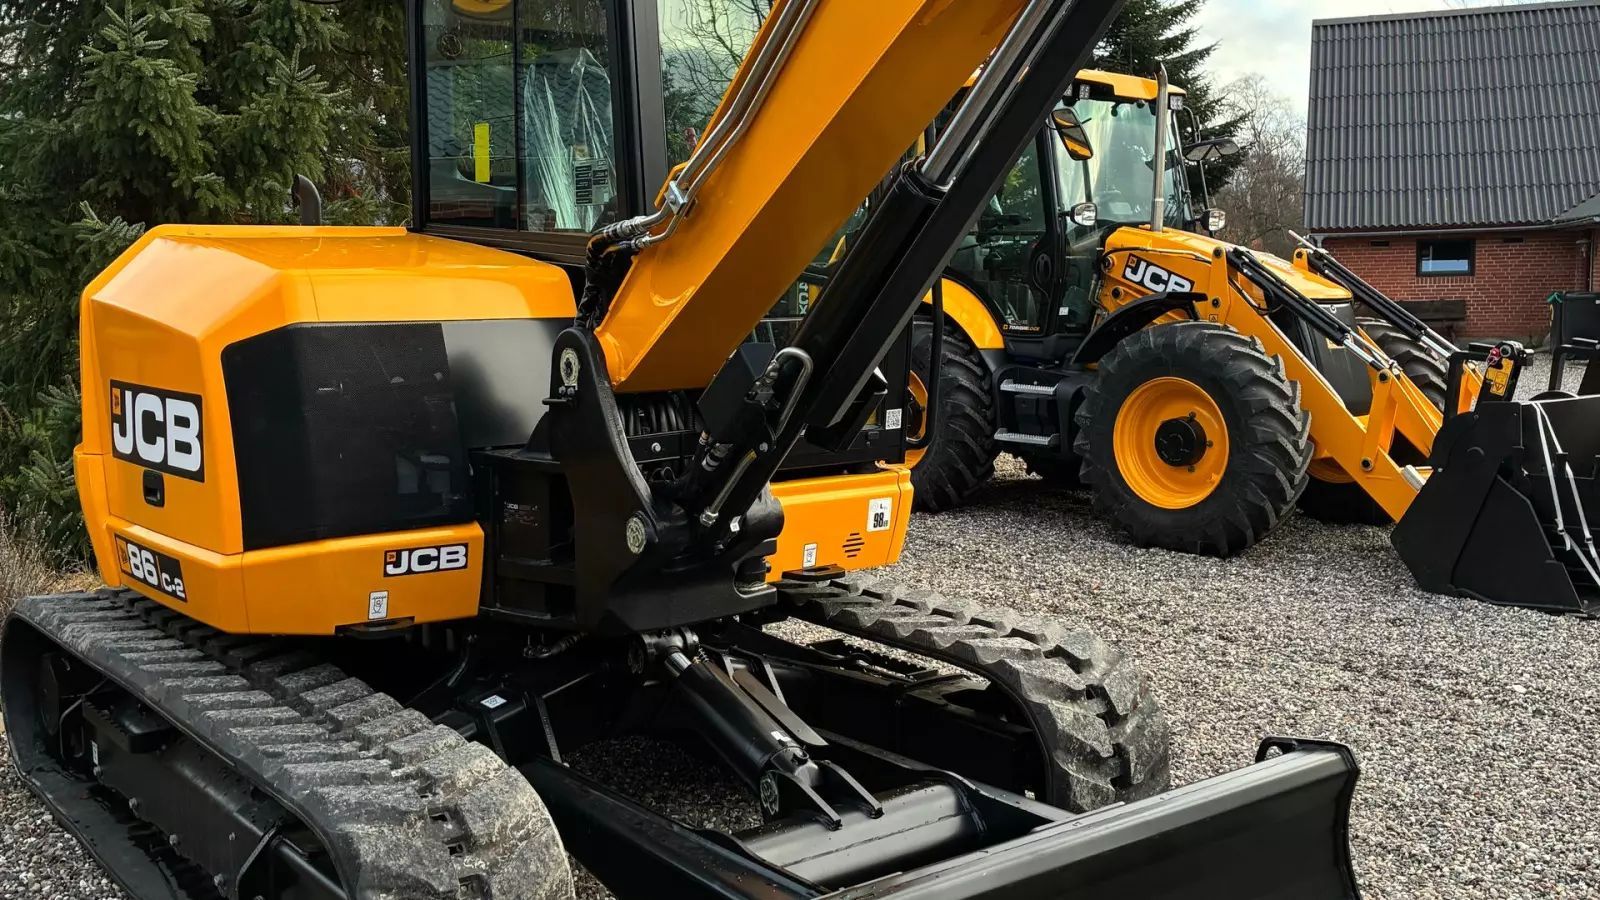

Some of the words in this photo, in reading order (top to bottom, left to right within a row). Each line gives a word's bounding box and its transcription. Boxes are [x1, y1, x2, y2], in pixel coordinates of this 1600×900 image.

[798, 281, 809, 315] 4CX
[112, 389, 202, 472] JCB
[127, 543, 159, 586] 86
[161, 572, 186, 598] C-2
[385, 545, 467, 575] JCB
